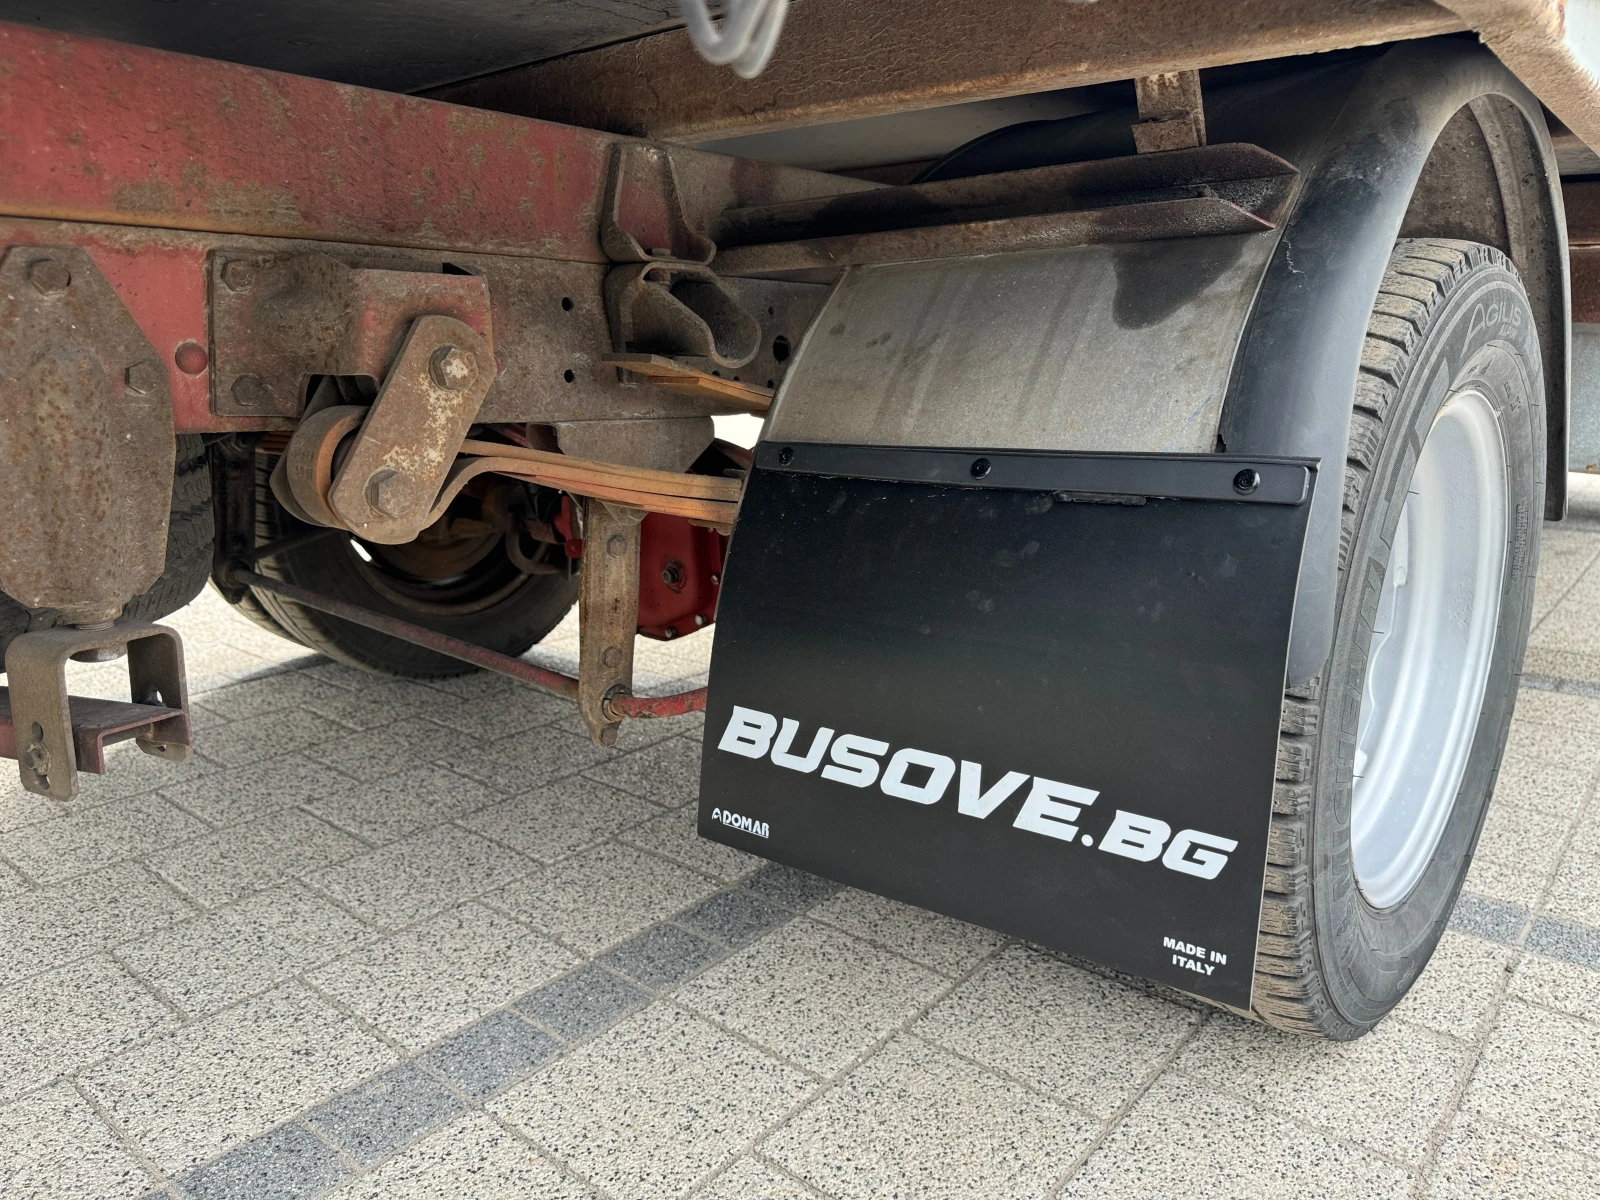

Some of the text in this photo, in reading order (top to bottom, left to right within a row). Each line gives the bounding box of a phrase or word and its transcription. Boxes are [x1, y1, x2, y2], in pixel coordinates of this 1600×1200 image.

[717, 705, 1239, 880] BUSOVE.BG
[711, 807, 770, 839] ADOMAR
[1163, 936, 1227, 966] MADE IN
[1172, 954, 1216, 976] ITALY
